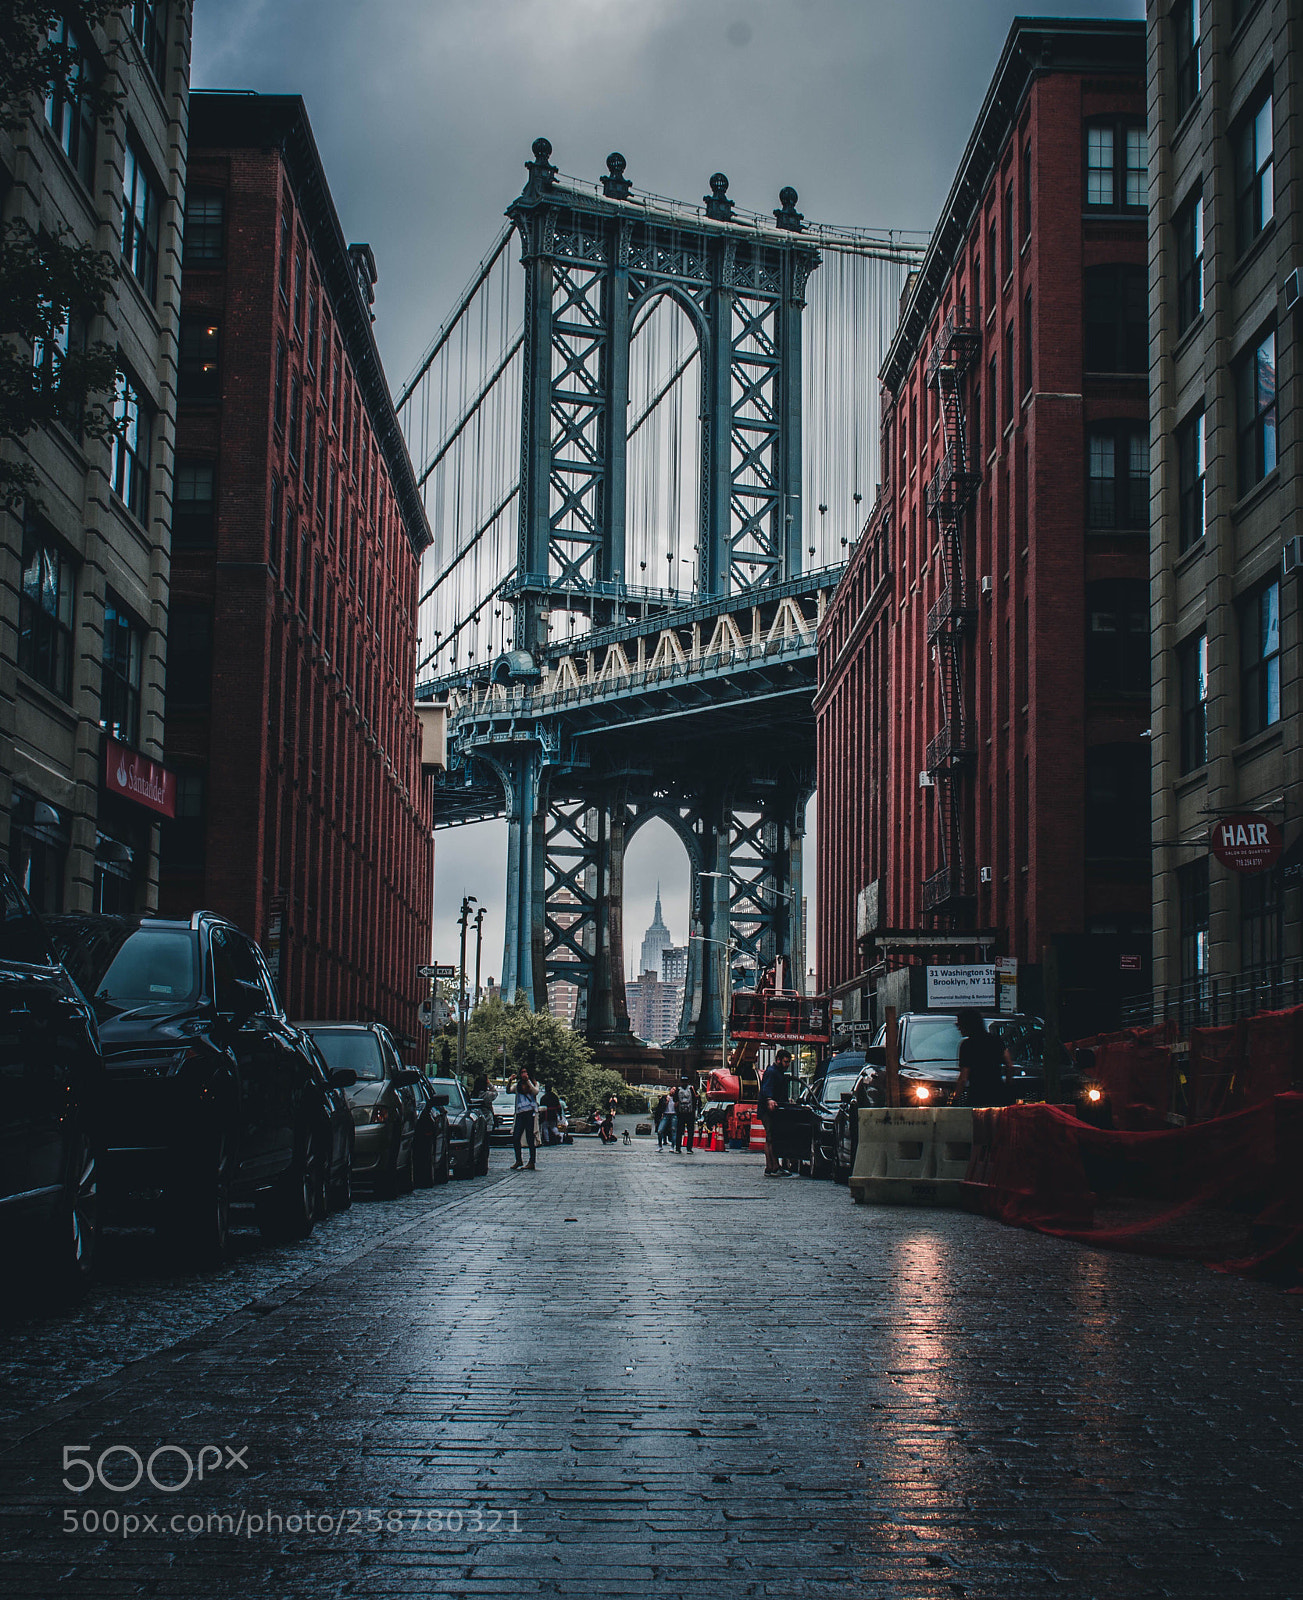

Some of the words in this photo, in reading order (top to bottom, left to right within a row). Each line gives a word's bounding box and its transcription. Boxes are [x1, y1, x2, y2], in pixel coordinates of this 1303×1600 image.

[128, 763, 166, 804] Santander
[1221, 823, 1270, 847] HAIR
[940, 969, 984, 978] Washington
[933, 978, 968, 986] Brooklyn,
